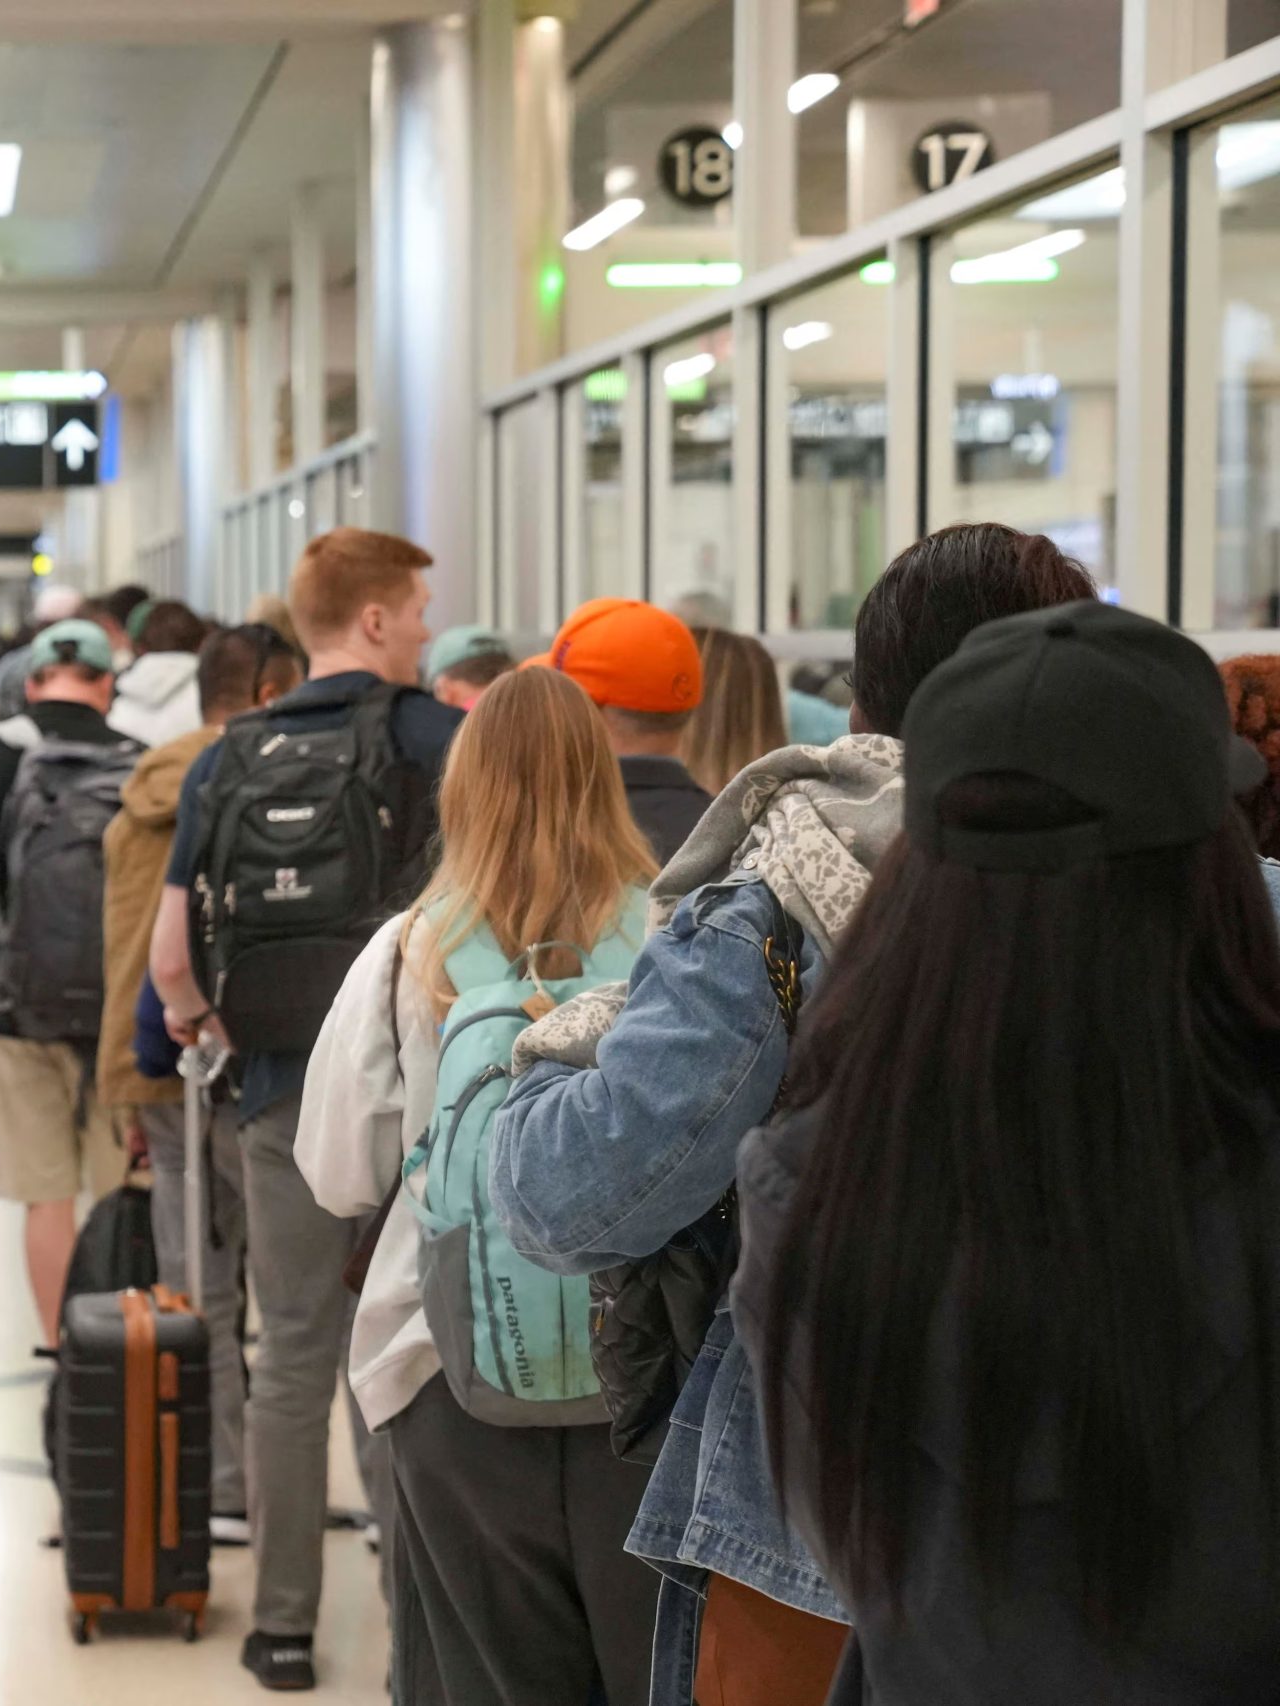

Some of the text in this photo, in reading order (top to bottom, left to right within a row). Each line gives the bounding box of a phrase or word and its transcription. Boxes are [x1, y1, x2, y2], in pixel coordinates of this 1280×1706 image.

[670, 138, 732, 196] 18
[920, 132, 988, 190] 17
[496, 1276, 536, 1388] patagonia
